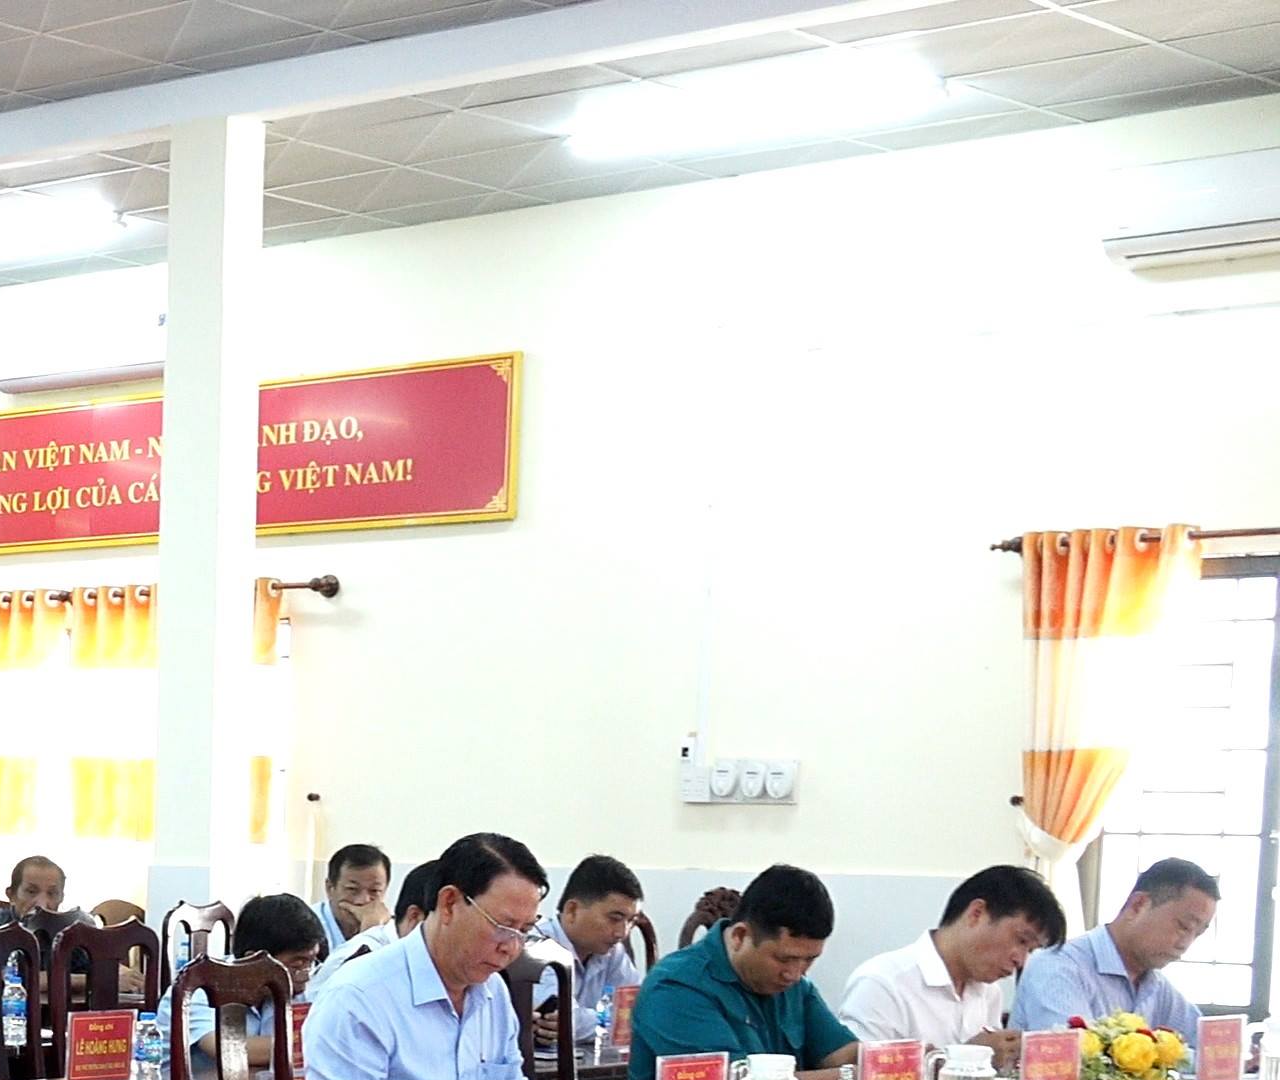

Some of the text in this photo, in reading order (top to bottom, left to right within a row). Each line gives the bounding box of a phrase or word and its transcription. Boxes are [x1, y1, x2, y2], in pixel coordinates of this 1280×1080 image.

[23, 441, 75, 473] VIỆT
[79, 439, 130, 464] NAM
[258, 422, 297, 447] NH
[303, 416, 363, 445] ĐẠO,
[33, 489, 70, 516] LỢI
[76, 479, 122, 509] CỦA
[128, 473, 159, 503] CÁ
[278, 461, 339, 493] VIỆT
[344, 458, 413, 486] NAM!
